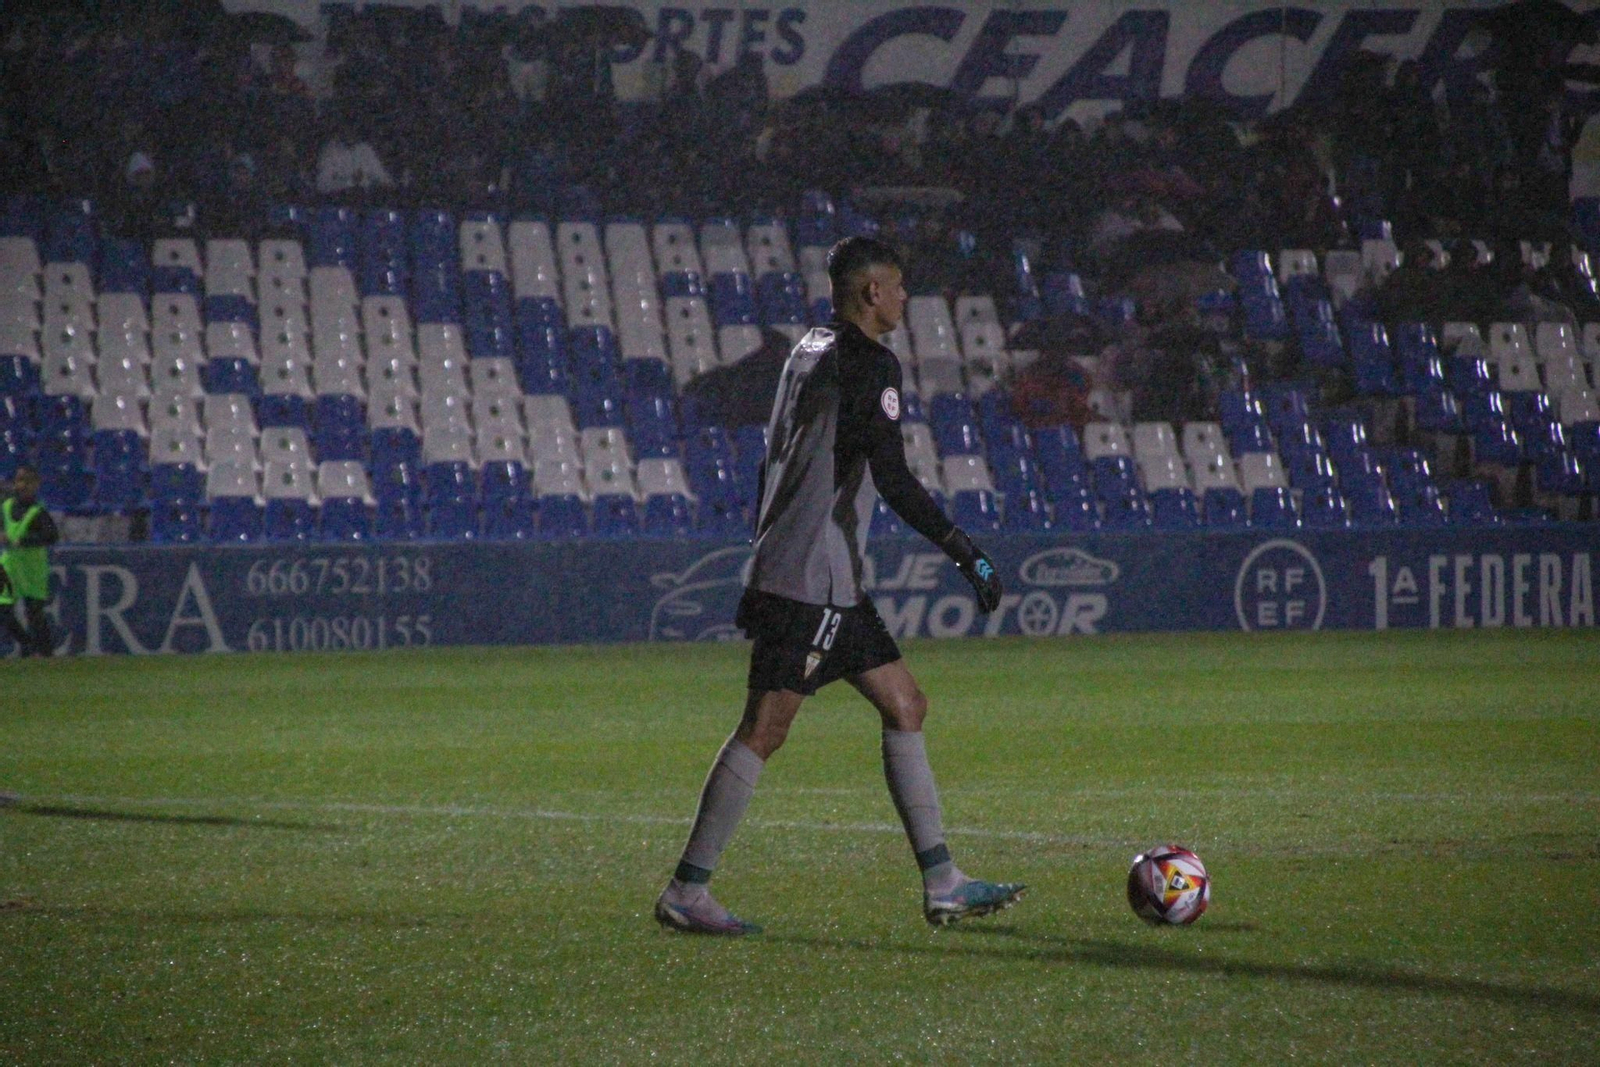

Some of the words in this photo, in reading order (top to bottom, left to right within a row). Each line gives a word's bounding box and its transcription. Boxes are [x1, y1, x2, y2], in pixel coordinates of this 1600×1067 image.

[247, 557, 432, 595] 666752138
[1429, 552, 1595, 629] FEDERA
[247, 614, 432, 653] 610080155
[812, 608, 842, 651] 13
